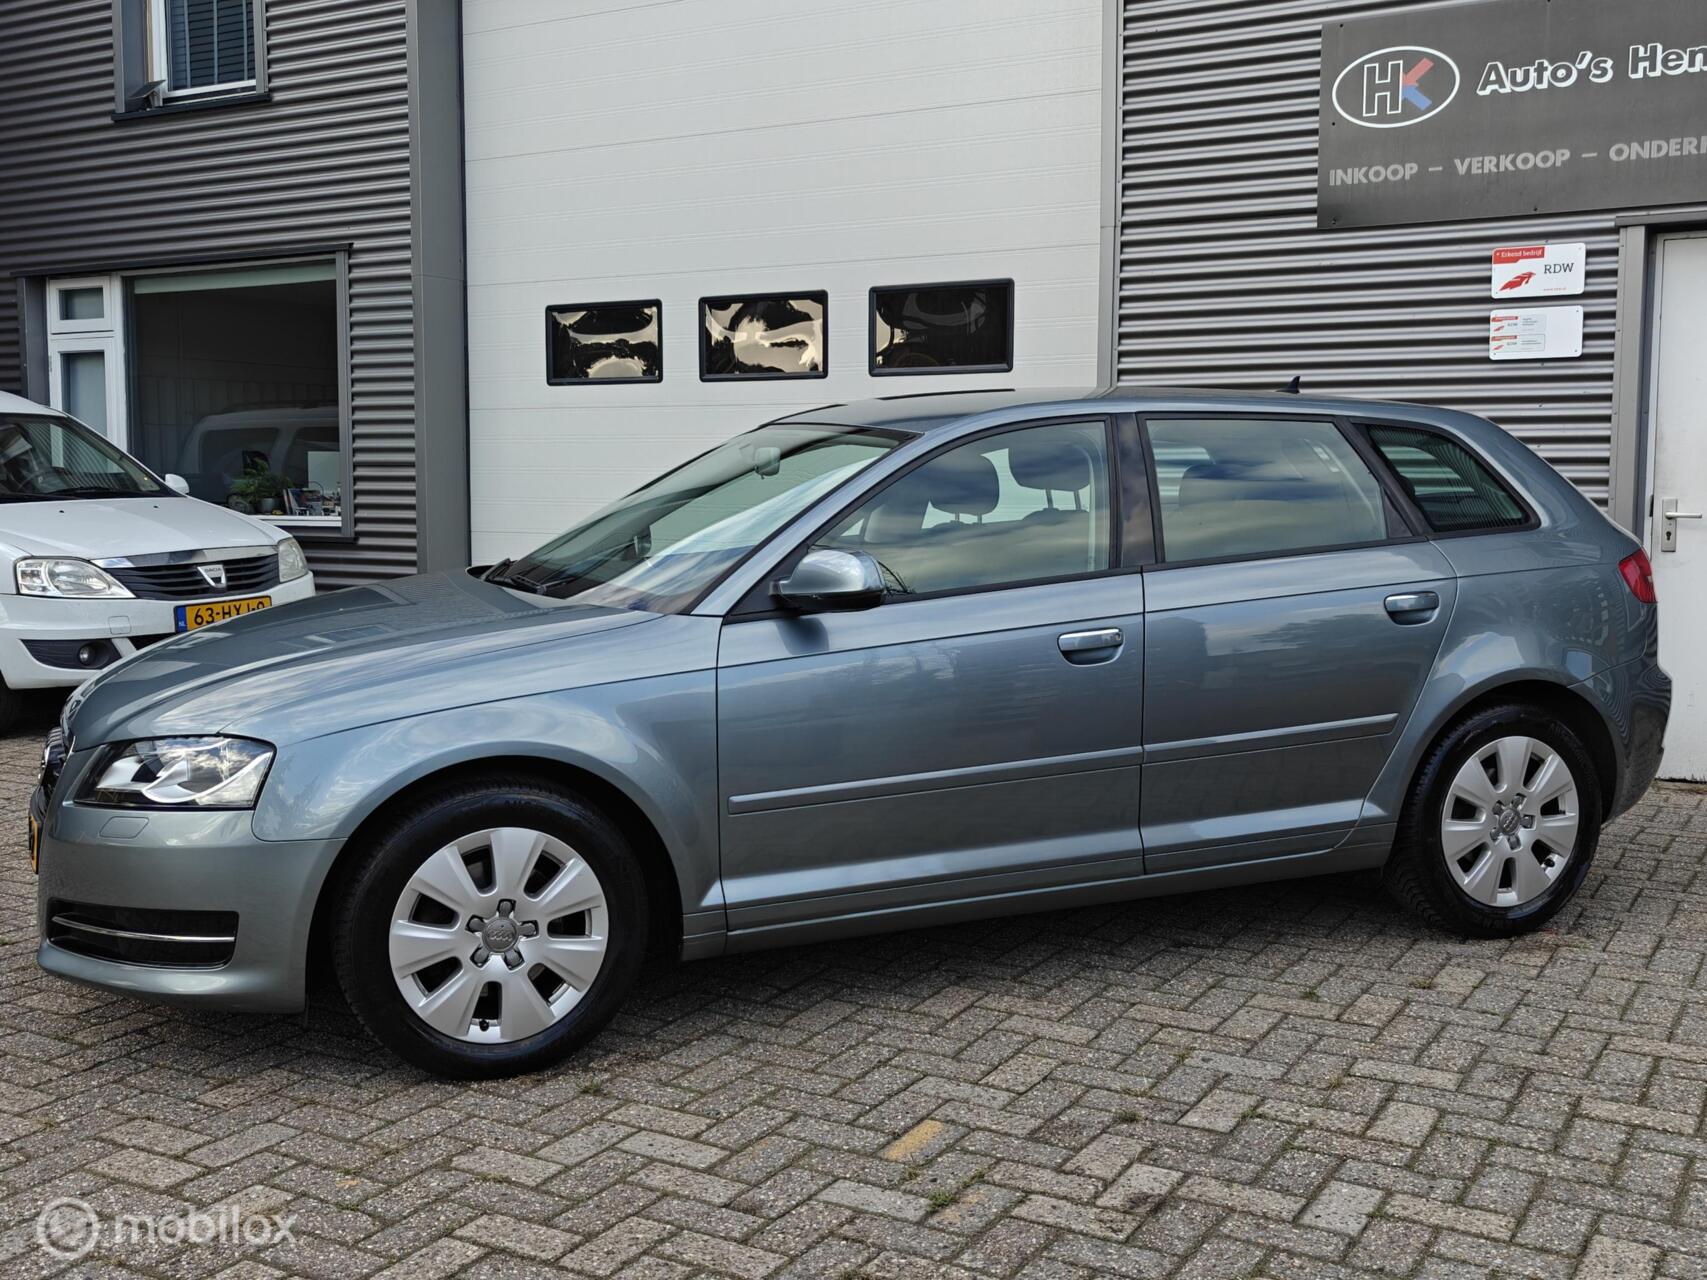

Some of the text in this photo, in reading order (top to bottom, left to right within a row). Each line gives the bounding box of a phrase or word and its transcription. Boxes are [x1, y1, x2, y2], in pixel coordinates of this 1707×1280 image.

[1362, 57, 1434, 117] HK
[1476, 42, 1707, 96] Auto's Hen
[1329, 162, 1419, 186] INKOOP
[1454, 148, 1571, 176] VERKOOP
[1523, 248, 1543, 257] bedrijf
[1543, 262, 1575, 275] RDW
